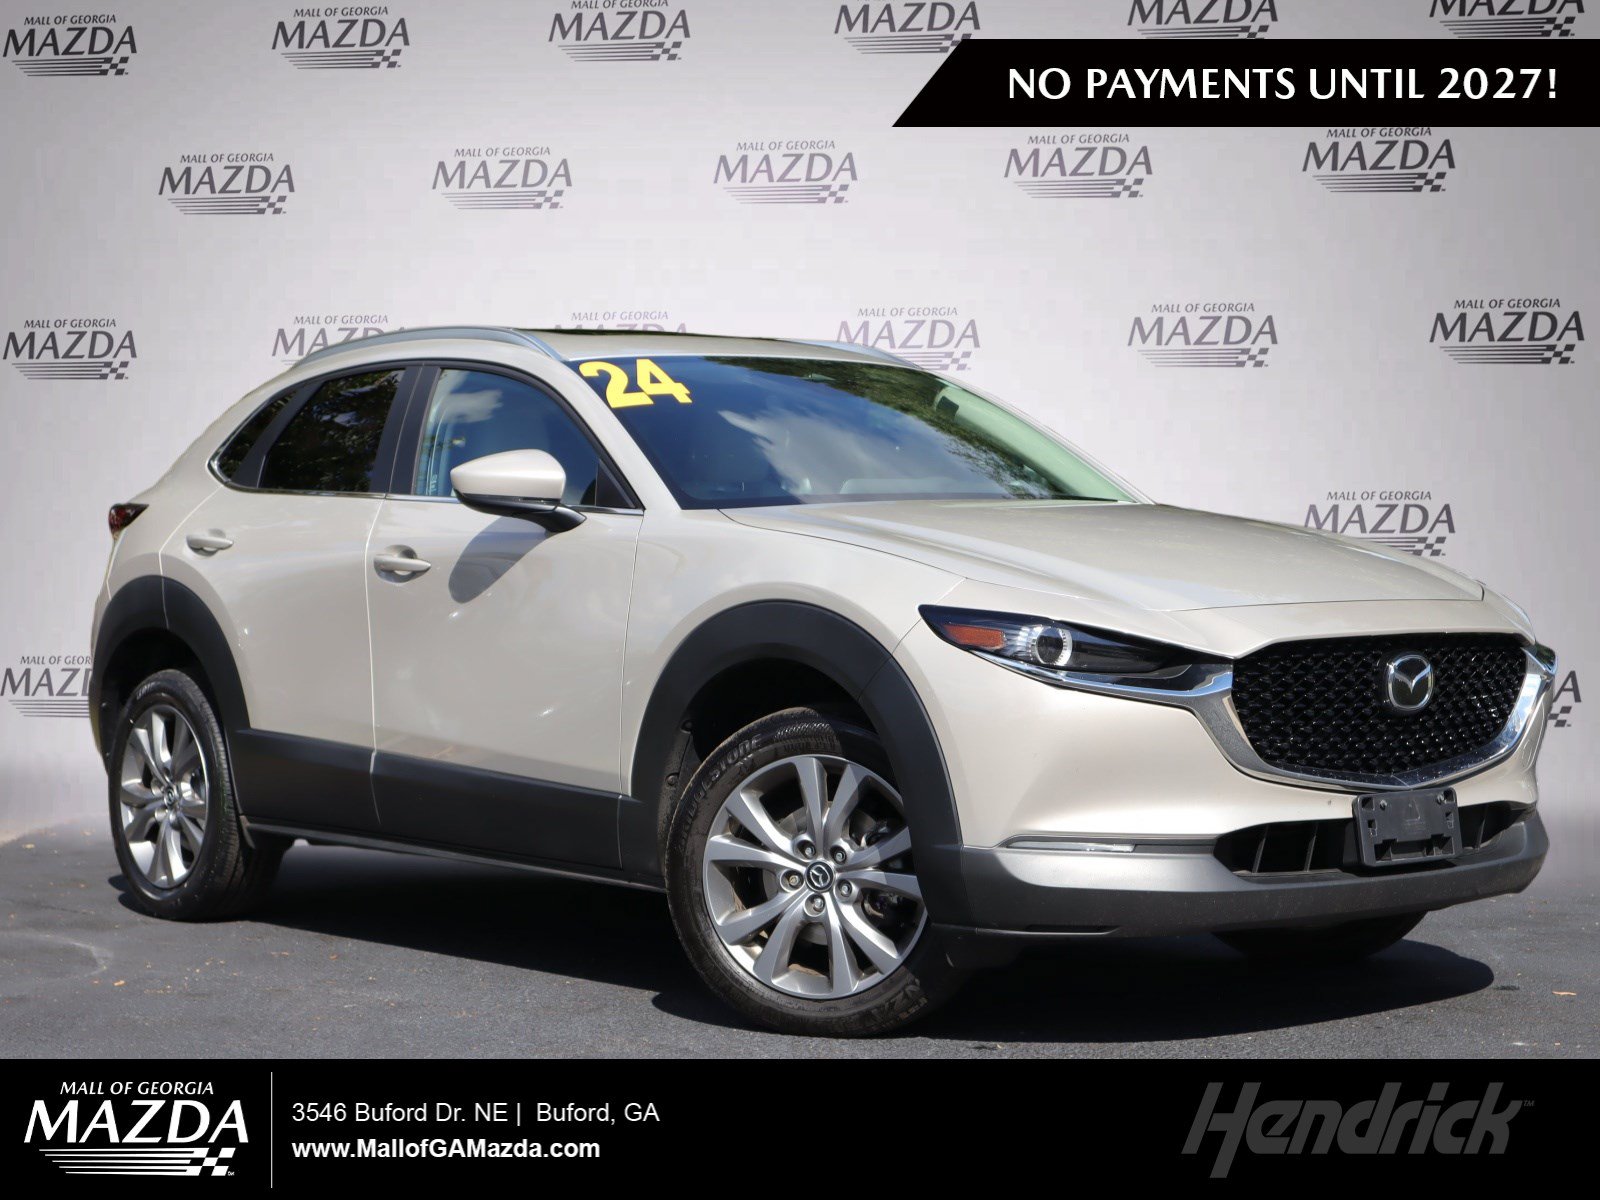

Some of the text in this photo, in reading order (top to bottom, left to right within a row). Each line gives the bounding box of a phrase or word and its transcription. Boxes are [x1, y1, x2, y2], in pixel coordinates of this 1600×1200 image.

[293, 6, 389, 18] MALL OF GEORGIA
[571, 0, 669, 9] MALL OF GEORGIA
[1127, 0, 1279, 26] MAZDA
[23, 14, 117, 26] MALL OF GEORGIA
[548, 9, 691, 42] MAZDA
[834, 1, 981, 34] MAZDA
[2, 25, 138, 58] MAZDA
[271, 17, 410, 51] MAZDA
[1027, 133, 1130, 145] MALL OF GEORGIA
[1326, 127, 1432, 138] MALL OF GEORGIA
[454, 146, 551, 158] MALL OF GEORGIA
[736, 140, 836, 151] MALL OF GEORGIA
[1302, 138, 1456, 172] MAZDA
[180, 152, 274, 164] MALL OF GEORGIA
[1003, 145, 1153, 178] MAZDA
[431, 158, 573, 190] MAZDA
[713, 152, 858, 184] MAZDA
[158, 164, 295, 195] MAZDA
[857, 306, 958, 317] MALL OF GEORGIA
[1151, 302, 1255, 313] MALL OF GEORGIA
[1454, 298, 1561, 309] MALL OF GEORGIA
[23, 318, 117, 329] MALL OF GEORGIA
[293, 314, 389, 325] MALL OF GEORGIA
[571, 310, 669, 321] MALL OF GEORGIA
[836, 318, 981, 349] MAZDA
[1127, 314, 1279, 346] MAZDA
[1429, 310, 1585, 343] MAZDA
[2, 330, 138, 360] MAZDA
[578, 358, 693, 409] 24
[1326, 490, 1432, 501] MALL OF GEORGIA
[1303, 503, 1456, 534] MAZDA
[20, 655, 91, 665] MALL OF GEOR
